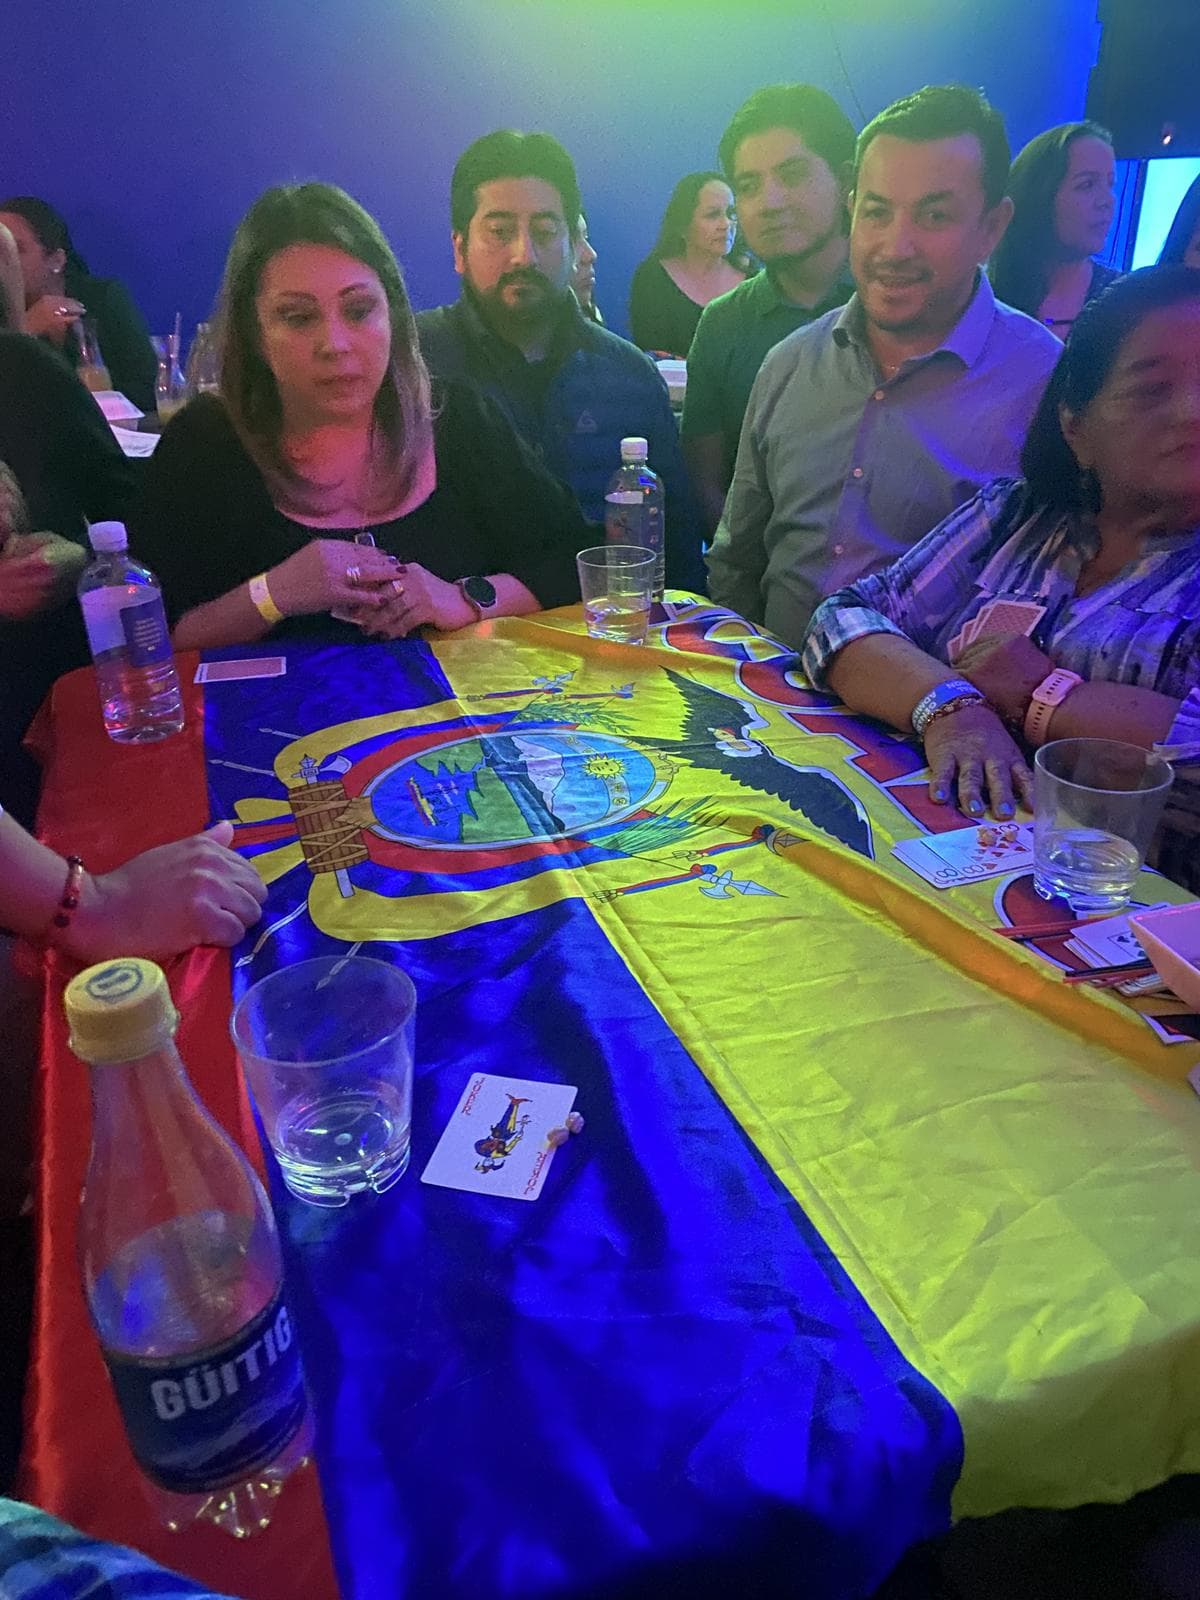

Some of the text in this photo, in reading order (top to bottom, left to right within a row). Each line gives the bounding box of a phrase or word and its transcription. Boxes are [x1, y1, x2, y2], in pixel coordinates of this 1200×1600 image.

[936, 868, 958, 879] 8
[963, 865, 985, 876] 8
[461, 1077, 486, 1116] JOKER
[523, 1151, 548, 1195] JOKER
[150, 1305, 292, 1421] GÜITIG
